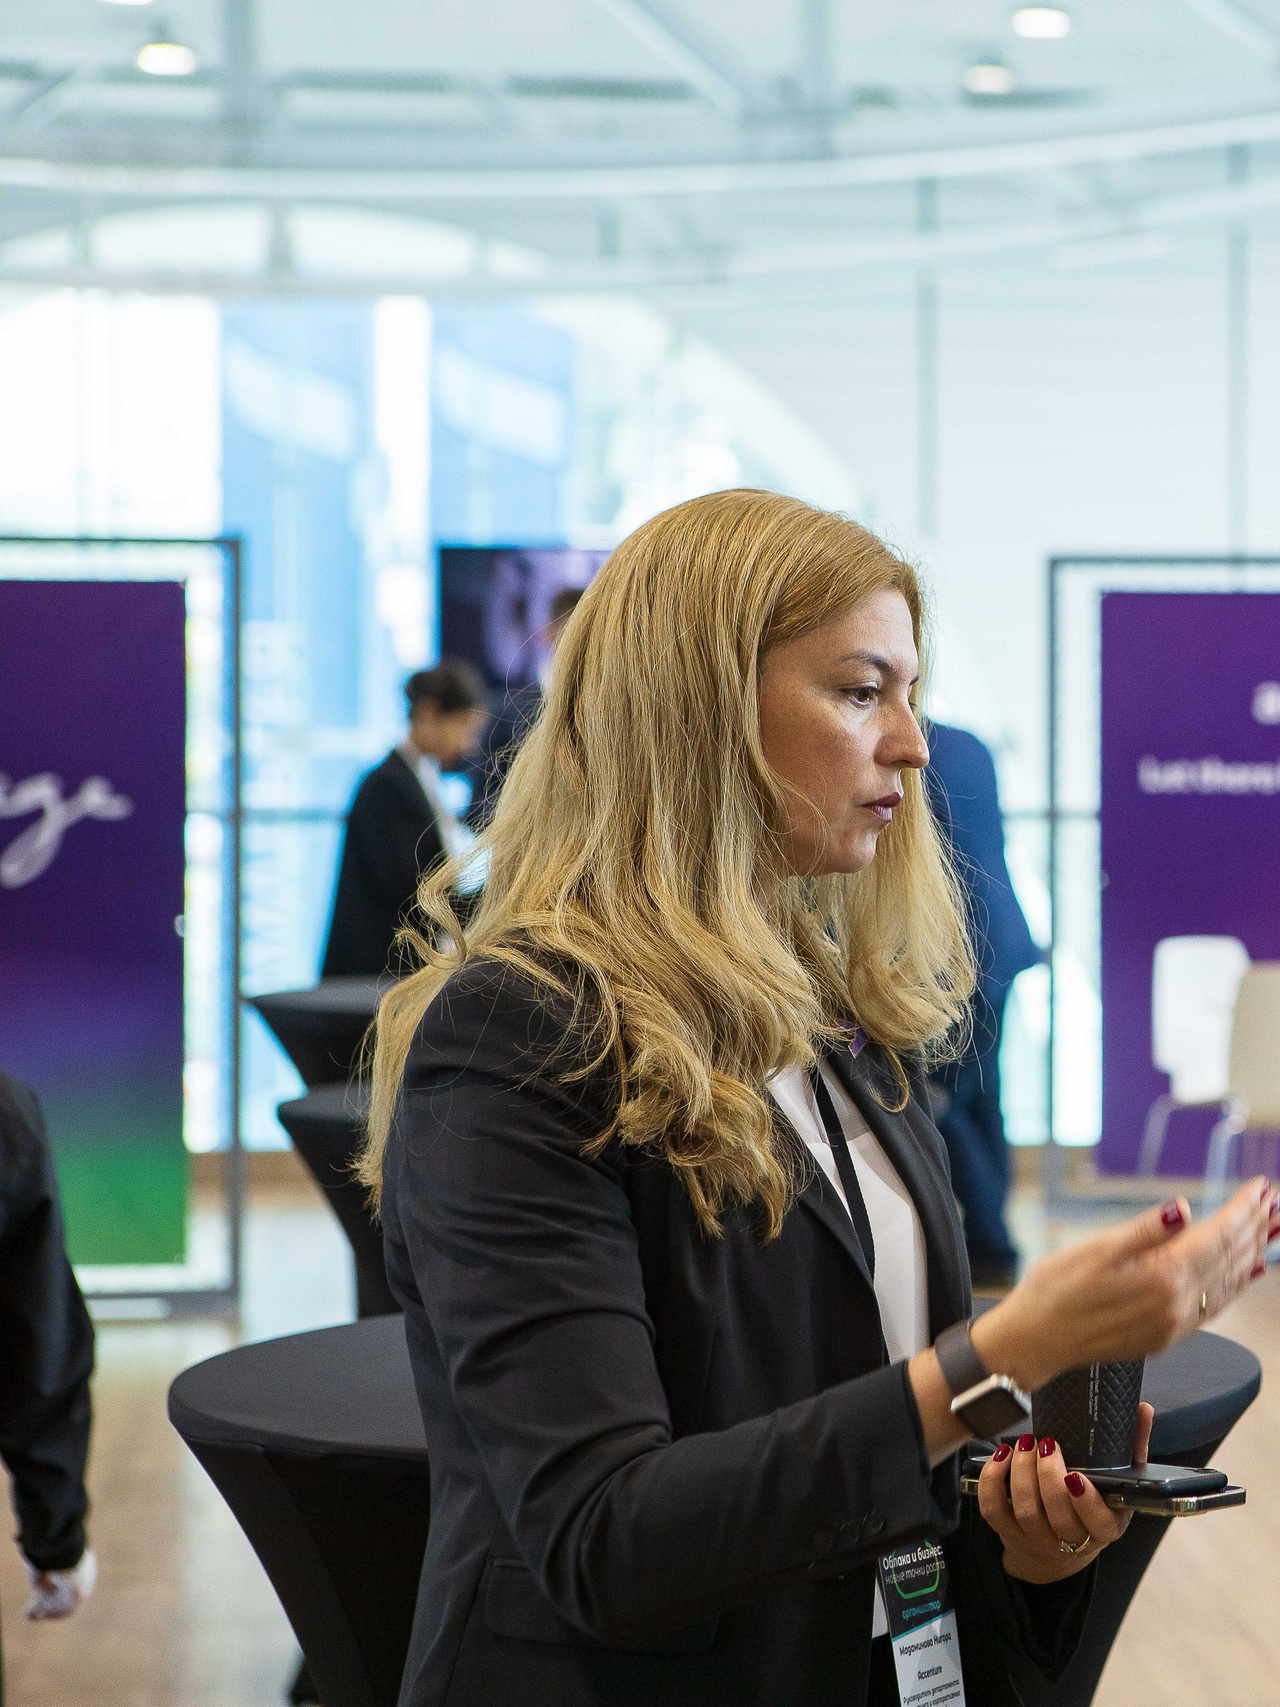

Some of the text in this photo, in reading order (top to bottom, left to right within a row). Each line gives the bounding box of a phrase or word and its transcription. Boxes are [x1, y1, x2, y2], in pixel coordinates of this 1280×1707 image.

[883, 1555, 910, 1569] Облака
[911, 1552, 917, 1563] и
[905, 1566, 926, 1579] точки
[917, 1665, 943, 1680] Accenture
